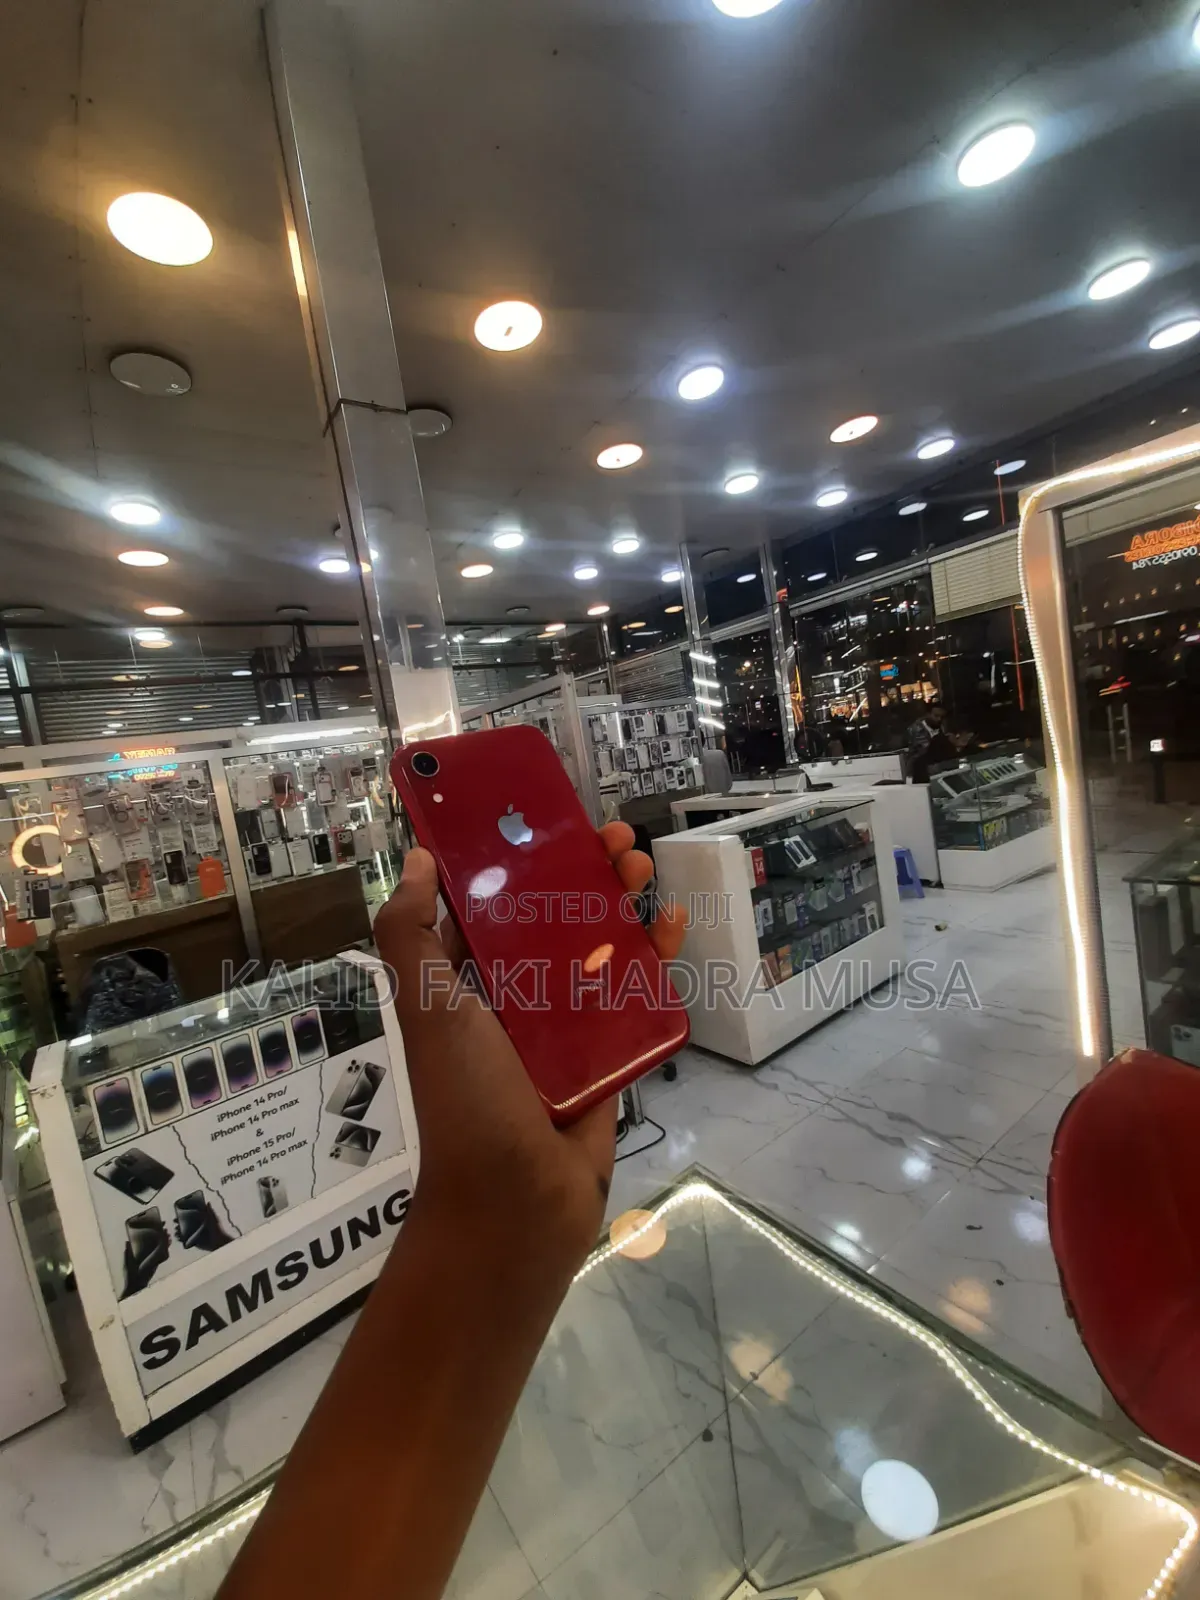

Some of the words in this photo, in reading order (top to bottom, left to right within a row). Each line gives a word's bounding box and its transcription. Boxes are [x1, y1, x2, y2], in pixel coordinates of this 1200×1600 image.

[210, 1121, 246, 1141] iPhone
[248, 1115, 259, 1125] 14
[261, 1107, 278, 1119] Pro
[280, 1098, 300, 1111] max
[217, 1103, 252, 1123] iPhone
[254, 1096, 265, 1106] 14
[267, 1085, 287, 1100] Pro/
[227, 1146, 261, 1166] iPhone
[263, 1138, 275, 1149] 15
[276, 1126, 296, 1143] Pro/
[256, 1128, 264, 1137] &
[221, 1164, 255, 1185] iPhone
[256, 1157, 268, 1168] 14
[270, 1150, 287, 1162] Pro
[288, 1139, 308, 1153] max
[139, 1188, 413, 1371] SAMSUNG
